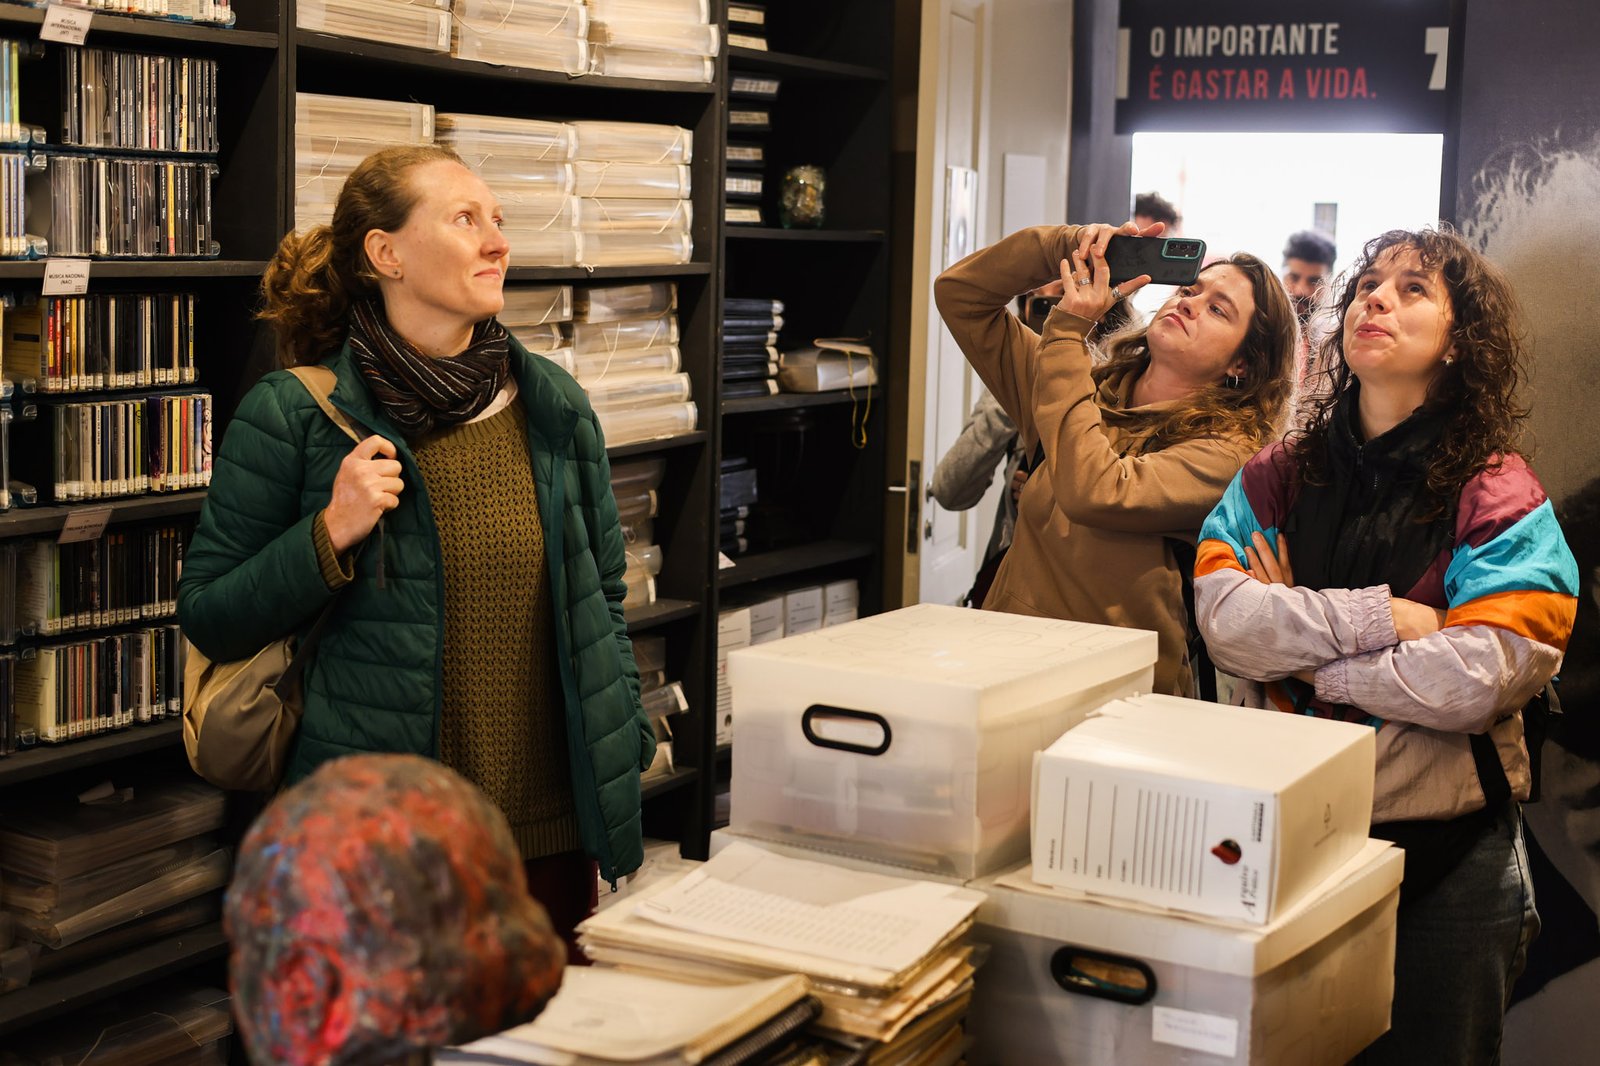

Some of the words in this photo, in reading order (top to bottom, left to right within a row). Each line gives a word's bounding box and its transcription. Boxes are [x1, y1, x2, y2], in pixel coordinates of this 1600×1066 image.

[1150, 26, 1165, 57] O
[1174, 23, 1340, 57] IMPORTANTE
[1149, 64, 1163, 100] É
[1171, 68, 1269, 100] GASTAR
[1278, 68, 1295, 99] A
[1306, 67, 1377, 99] VIDA.
